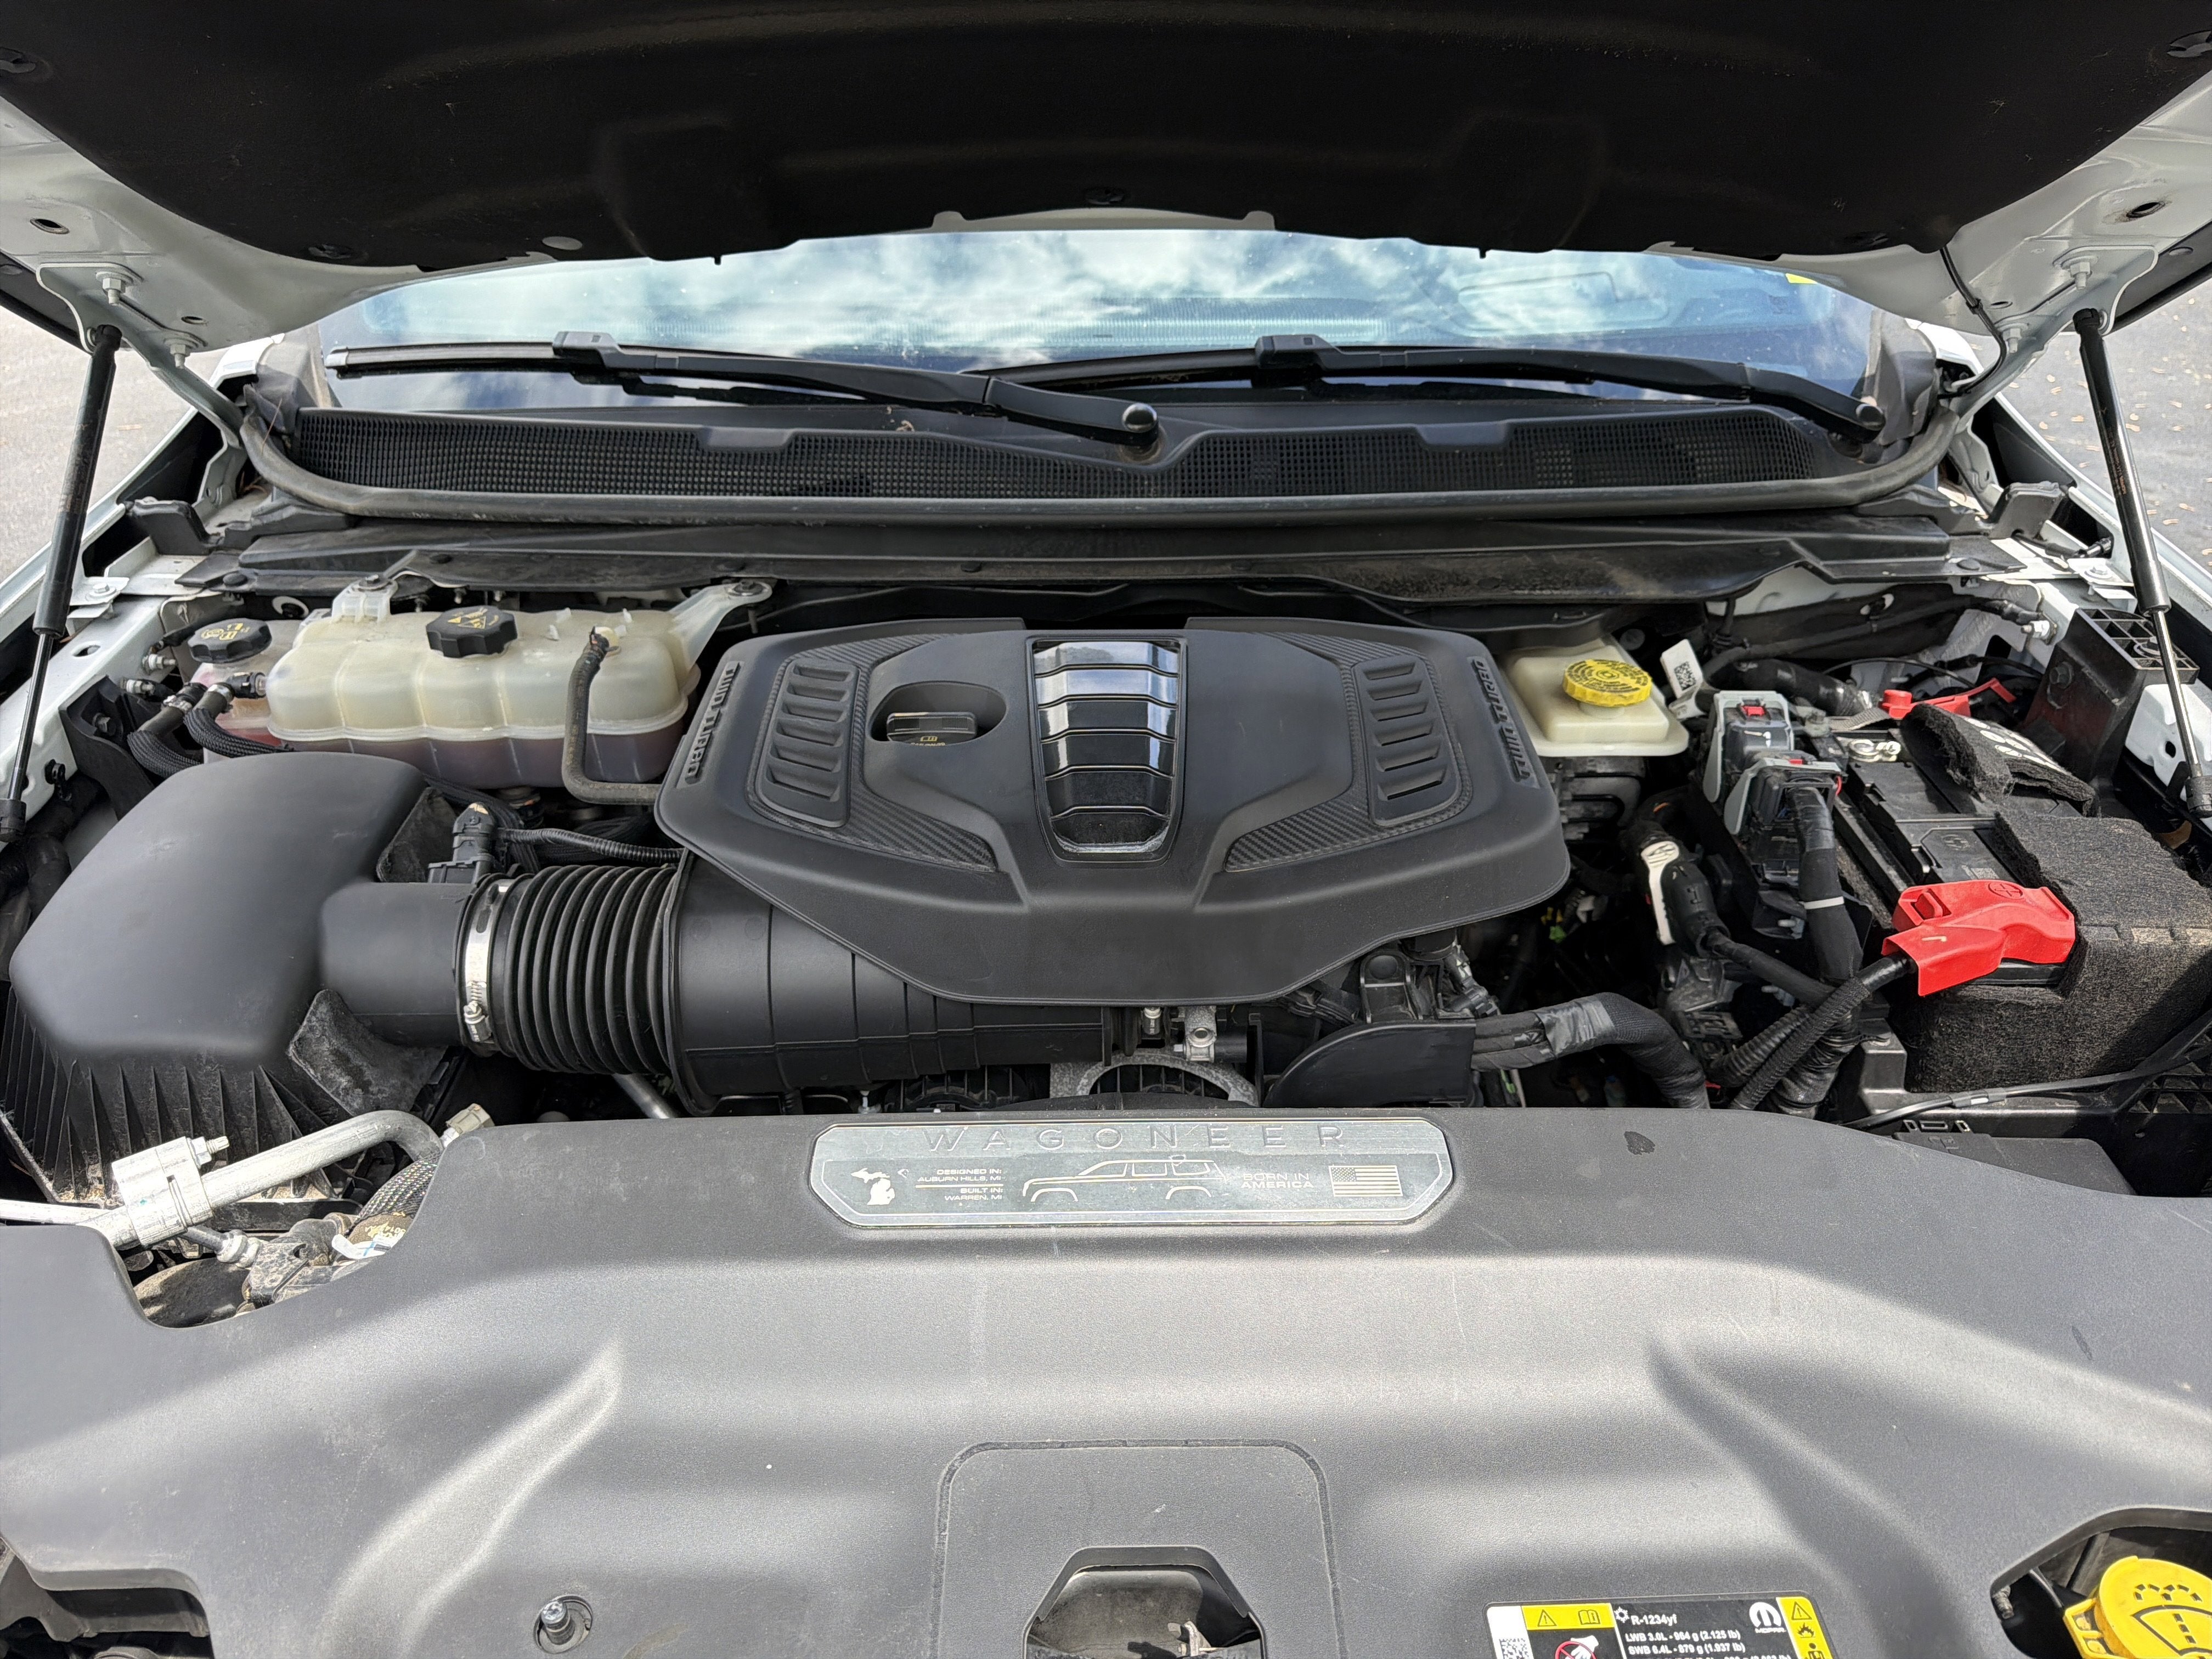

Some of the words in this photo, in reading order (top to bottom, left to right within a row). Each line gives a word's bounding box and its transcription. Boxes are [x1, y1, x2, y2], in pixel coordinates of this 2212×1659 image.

[922, 1125, 1344, 1152] WAGONEER
[1241, 1181, 1314, 1189] AMERICA
[1630, 1613, 1678, 1627] R-1234yf
[1625, 1633, 1647, 1641] LWB
[1647, 1632, 1668, 1641] 3.0L
[1691, 1633, 1699, 1641] g
[1700, 1629, 1727, 1641] (2.125
[1727, 1629, 1741, 1640] lb)
[1628, 1645, 1651, 1655] SWB
[1652, 1645, 1673, 1654] 6.4L
[1696, 1645, 1704, 1655] g
[1704, 1643, 1730, 1654] (1.937
[1732, 1642, 1746, 1653] lb)
